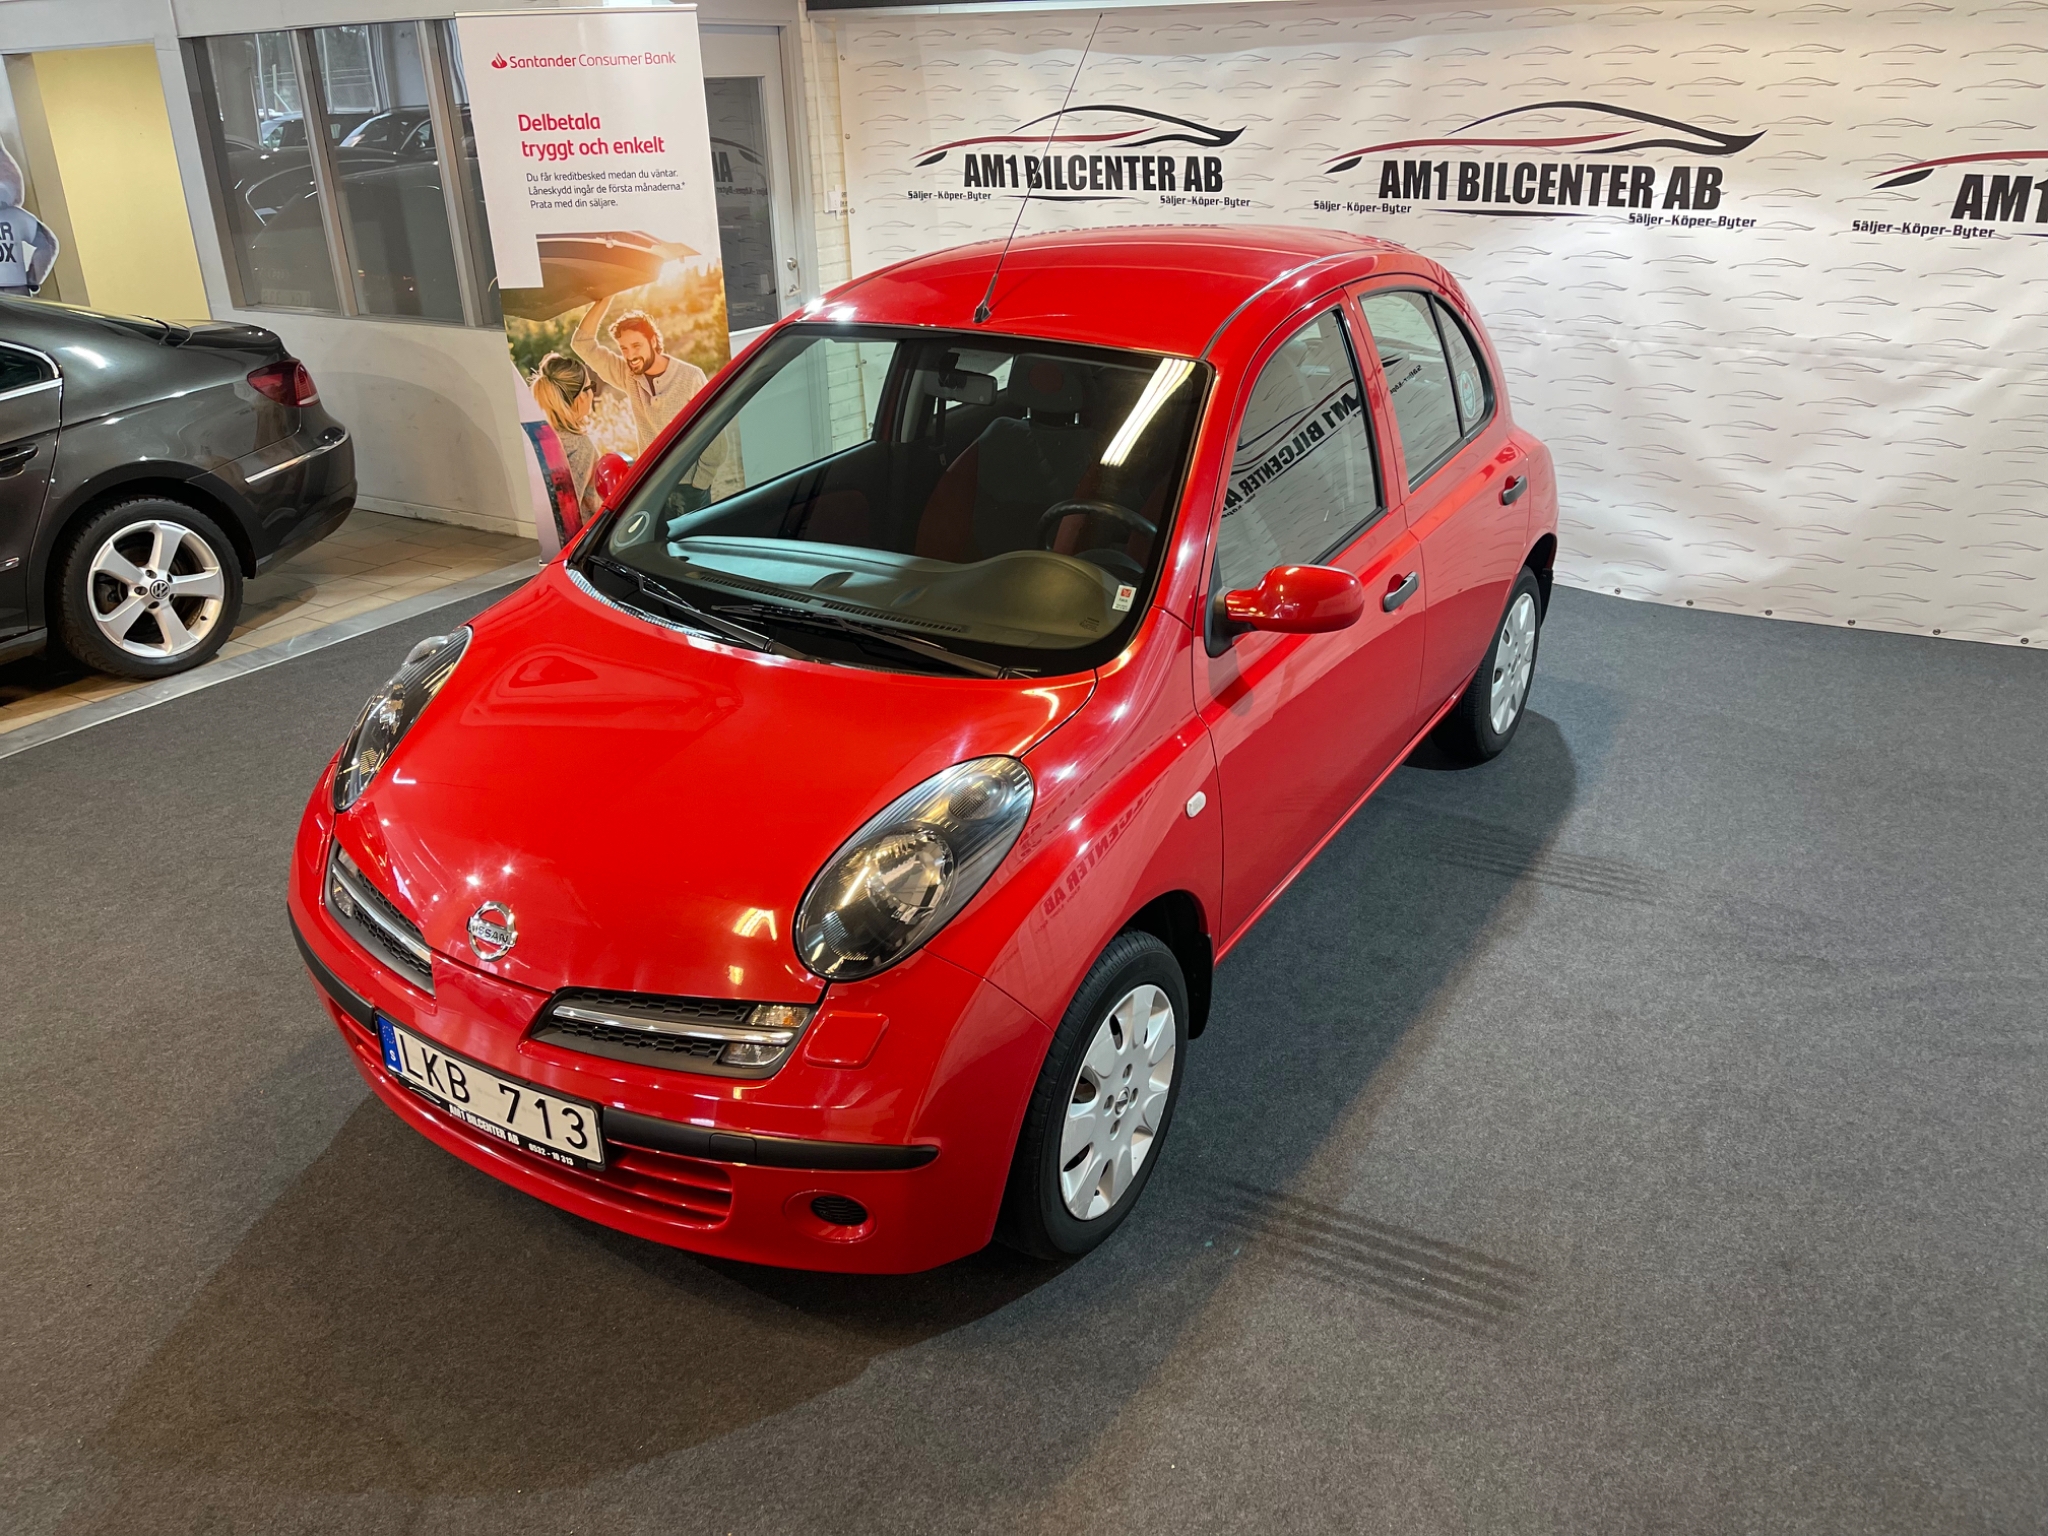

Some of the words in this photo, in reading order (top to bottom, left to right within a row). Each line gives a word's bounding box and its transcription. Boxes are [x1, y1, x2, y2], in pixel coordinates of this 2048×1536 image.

[510, 54, 576, 69] Santander
[578, 53, 642, 67] Consumer
[645, 52, 676, 65] Bank
[518, 113, 600, 132] Delbetala
[521, 139, 574, 161] tryggt
[579, 138, 609, 156] och
[613, 136, 665, 154] enkelt
[526, 173, 538, 182] Du
[540, 172, 551, 182] får
[554, 171, 606, 181] kreditbesked
[608, 170, 637, 179] medan
[638, 169, 649, 179] du
[651, 169, 678, 178] väntar.
[963, 154, 1019, 189] AM1
[1025, 154, 1176, 192] BILCENTER
[1183, 156, 1223, 193] AB
[528, 185, 572, 197] Låneskydd
[574, 184, 594, 196] ingår
[596, 184, 607, 194] de
[609, 183, 633, 193] första
[1378, 160, 1451, 201] AM1
[1456, 161, 1656, 209] BILCENTER
[1661, 165, 1724, 210] AB
[530, 200, 552, 209] Prata
[554, 199, 573, 208] med
[574, 198, 587, 208] din
[589, 198, 618, 209] säljare.
[1852, 220, 1996, 240] Säljer-Köper-Byter
[389, 1049, 397, 1062] S
[399, 1033, 470, 1104] LKB
[498, 1082, 588, 1150] 713
[448, 1103, 466, 1120] AM1
[507, 1131, 520, 1146] AB
